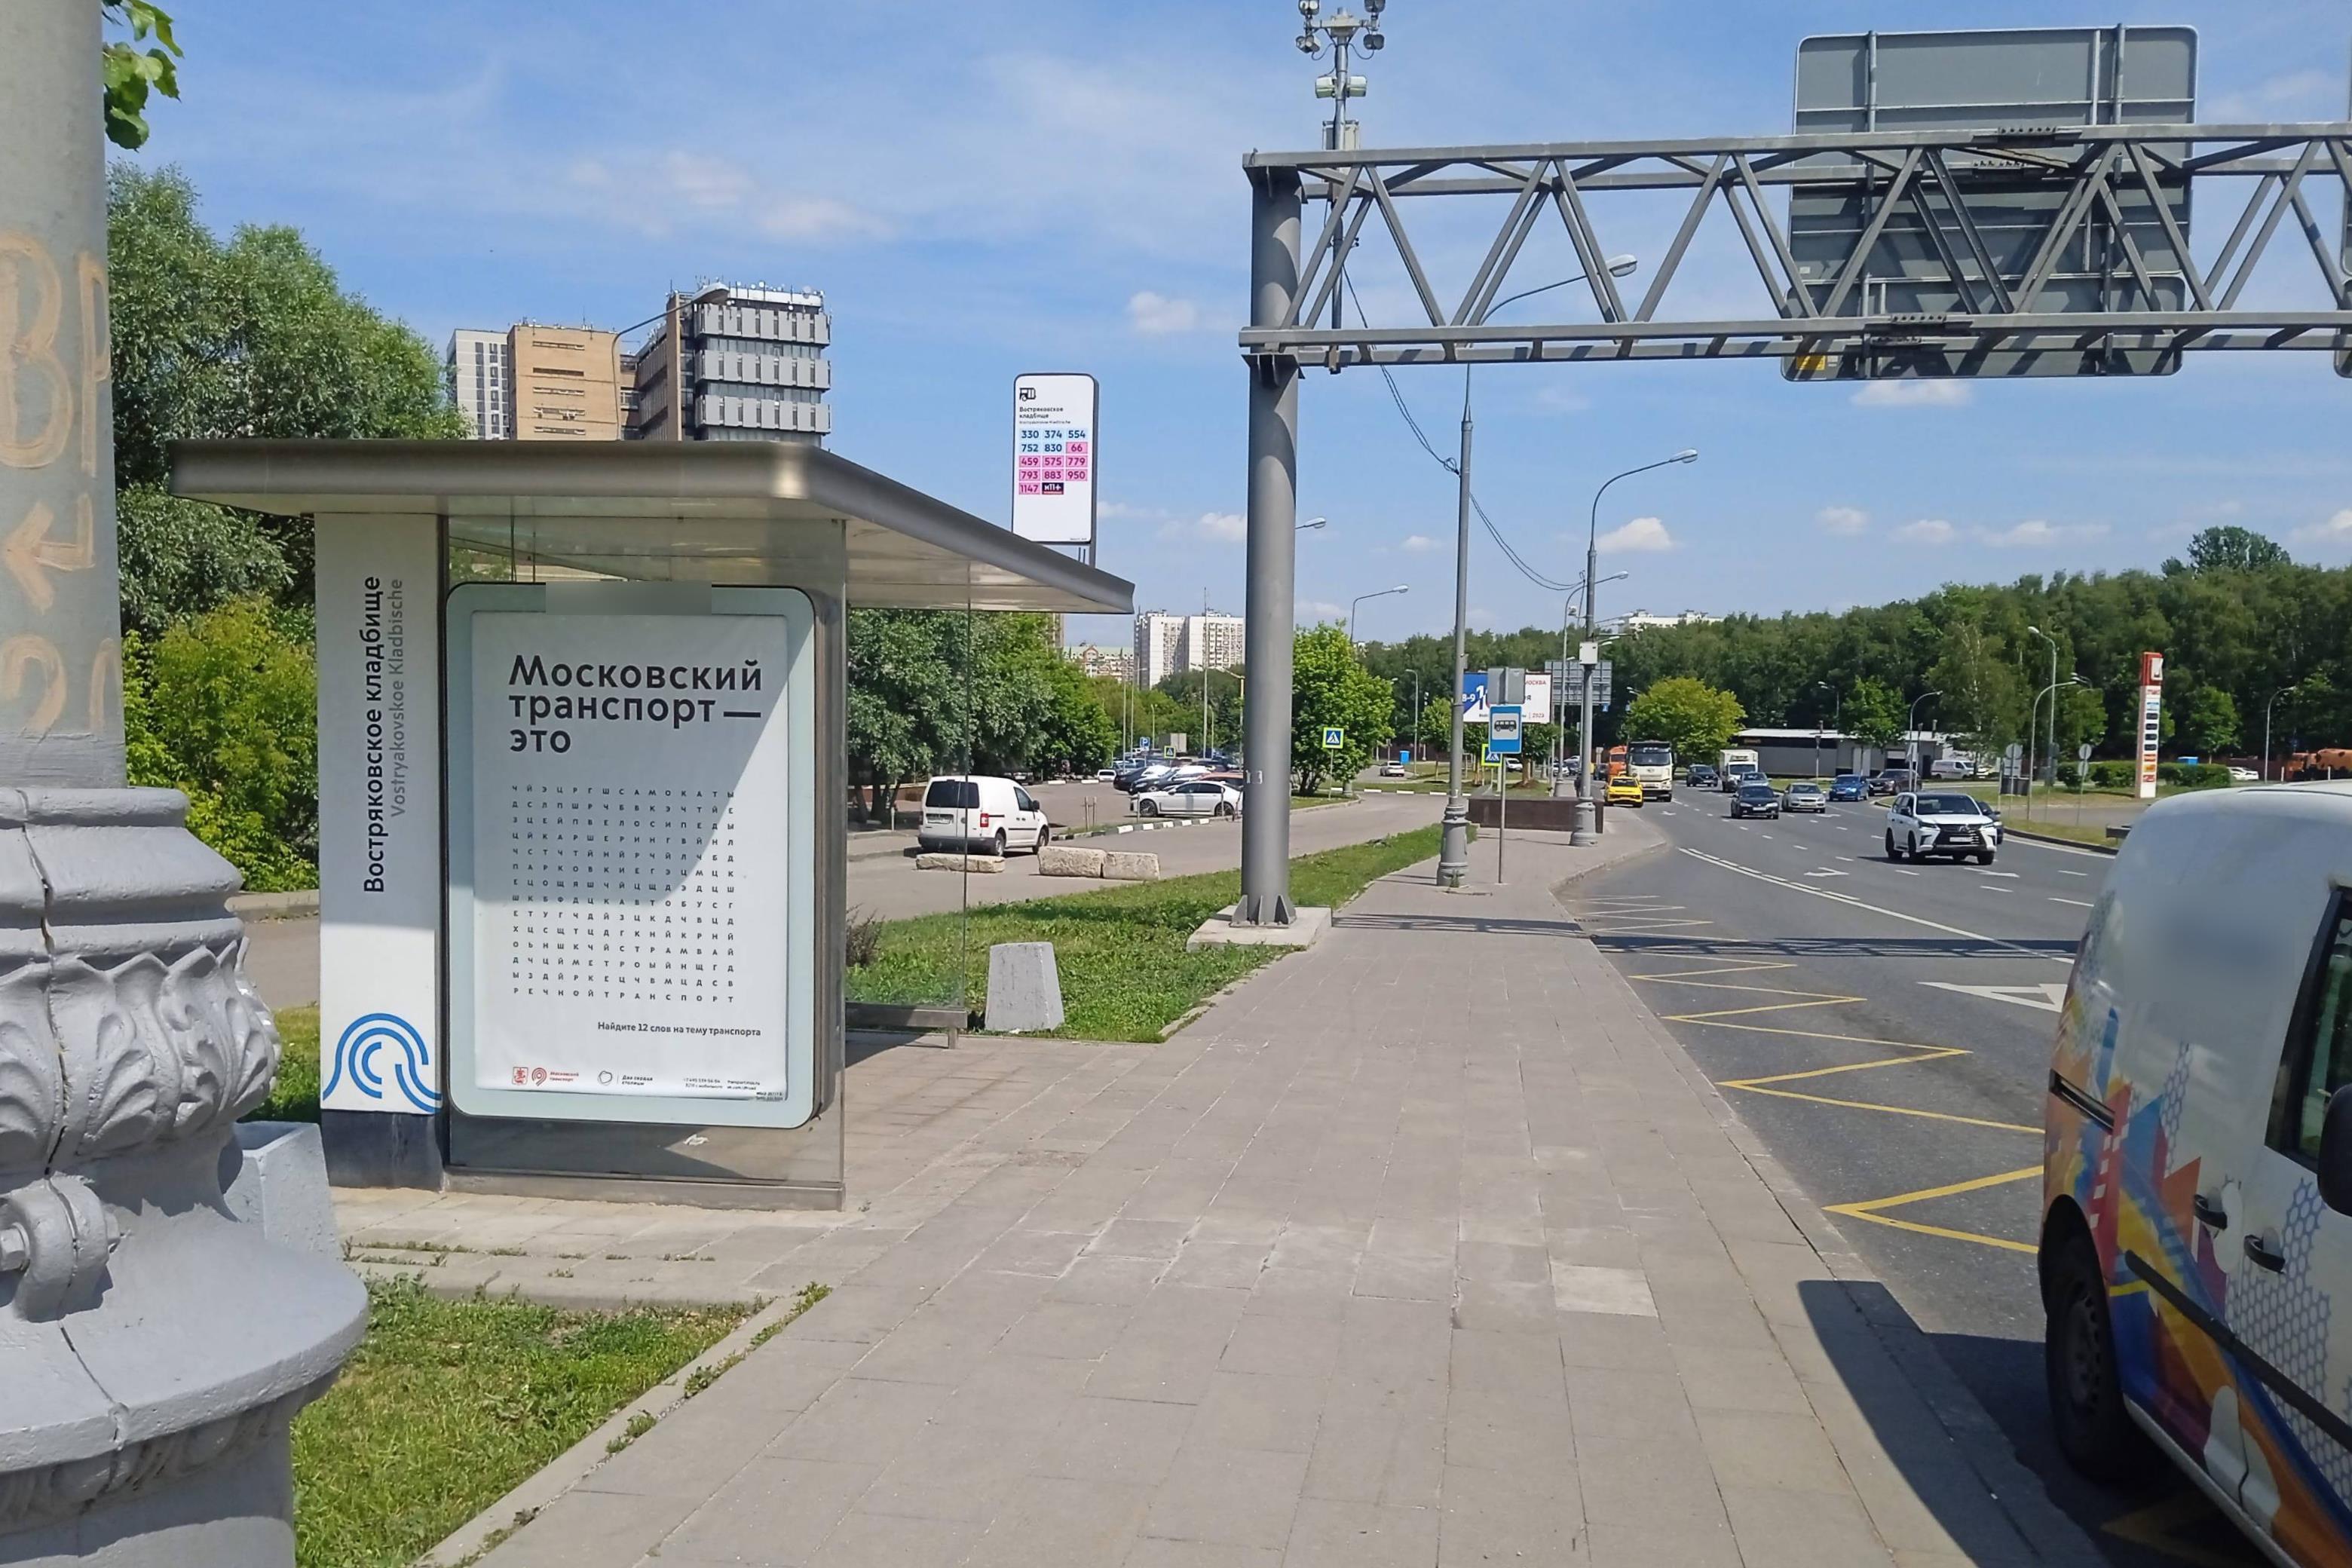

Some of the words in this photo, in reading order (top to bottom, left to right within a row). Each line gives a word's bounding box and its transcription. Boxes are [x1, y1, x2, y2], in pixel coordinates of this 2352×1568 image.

[1021, 430, 1040, 438] 330
[1044, 430, 1062, 438] 374
[1068, 430, 1086, 438] 554
[1021, 444, 1039, 452] 752
[1044, 444, 1062, 452] 830
[1070, 444, 1083, 452] 66
[1021, 458, 1039, 466] 459
[1044, 458, 1062, 466] 575
[1067, 458, 1086, 466] 779
[359, 576, 384, 701] кладбище
[388, 579, 405, 675] Kladbische
[508, 654, 761, 691] Московский
[509, 694, 716, 729] транспорт
[388, 681, 409, 817] Vostryakovskoe
[510, 730, 571, 754] это
[364, 708, 389, 893] Востряковское
[598, 1021, 636, 1032] Найдите
[686, 1027, 707, 1036] тему
[709, 1027, 761, 1037] транспорта
